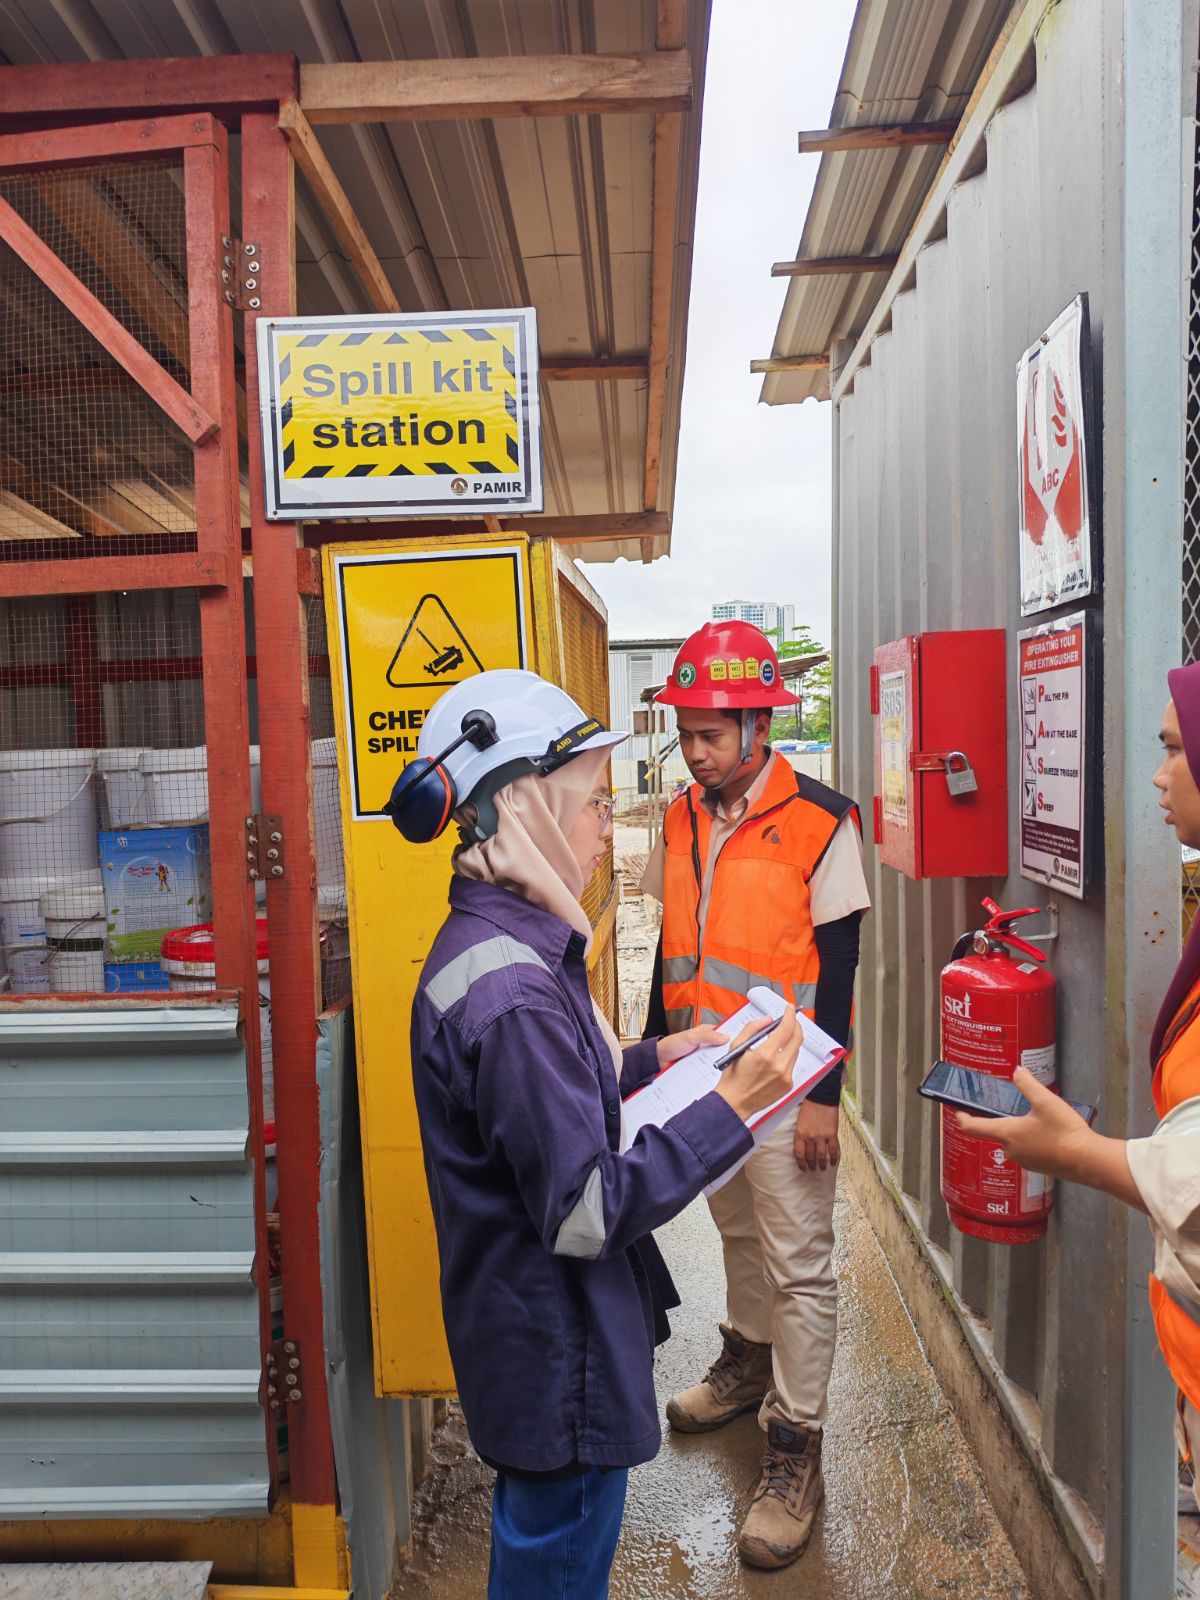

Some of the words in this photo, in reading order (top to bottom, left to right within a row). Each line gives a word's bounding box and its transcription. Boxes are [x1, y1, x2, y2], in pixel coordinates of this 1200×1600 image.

[302, 361, 414, 405] Spill
[432, 359, 493, 393] kit
[312, 413, 486, 449] station
[473, 481, 522, 494] PAMIR
[1041, 468, 1059, 496] ABC
[1027, 638, 1059, 656] OPERATING
[1060, 634, 1076, 649] YOUR
[1024, 659, 1037, 672] FIRE
[1038, 650, 1079, 669] EXTINGUISHER
[1052, 692, 1061, 701] THE
[368, 709, 431, 731] CHE
[1057, 730, 1065, 738] THE
[1060, 768, 1079, 778] TRIGGER
[1060, 864, 1078, 879] PAMIR
[947, 1015, 1002, 1033] EXTINGUISHER
